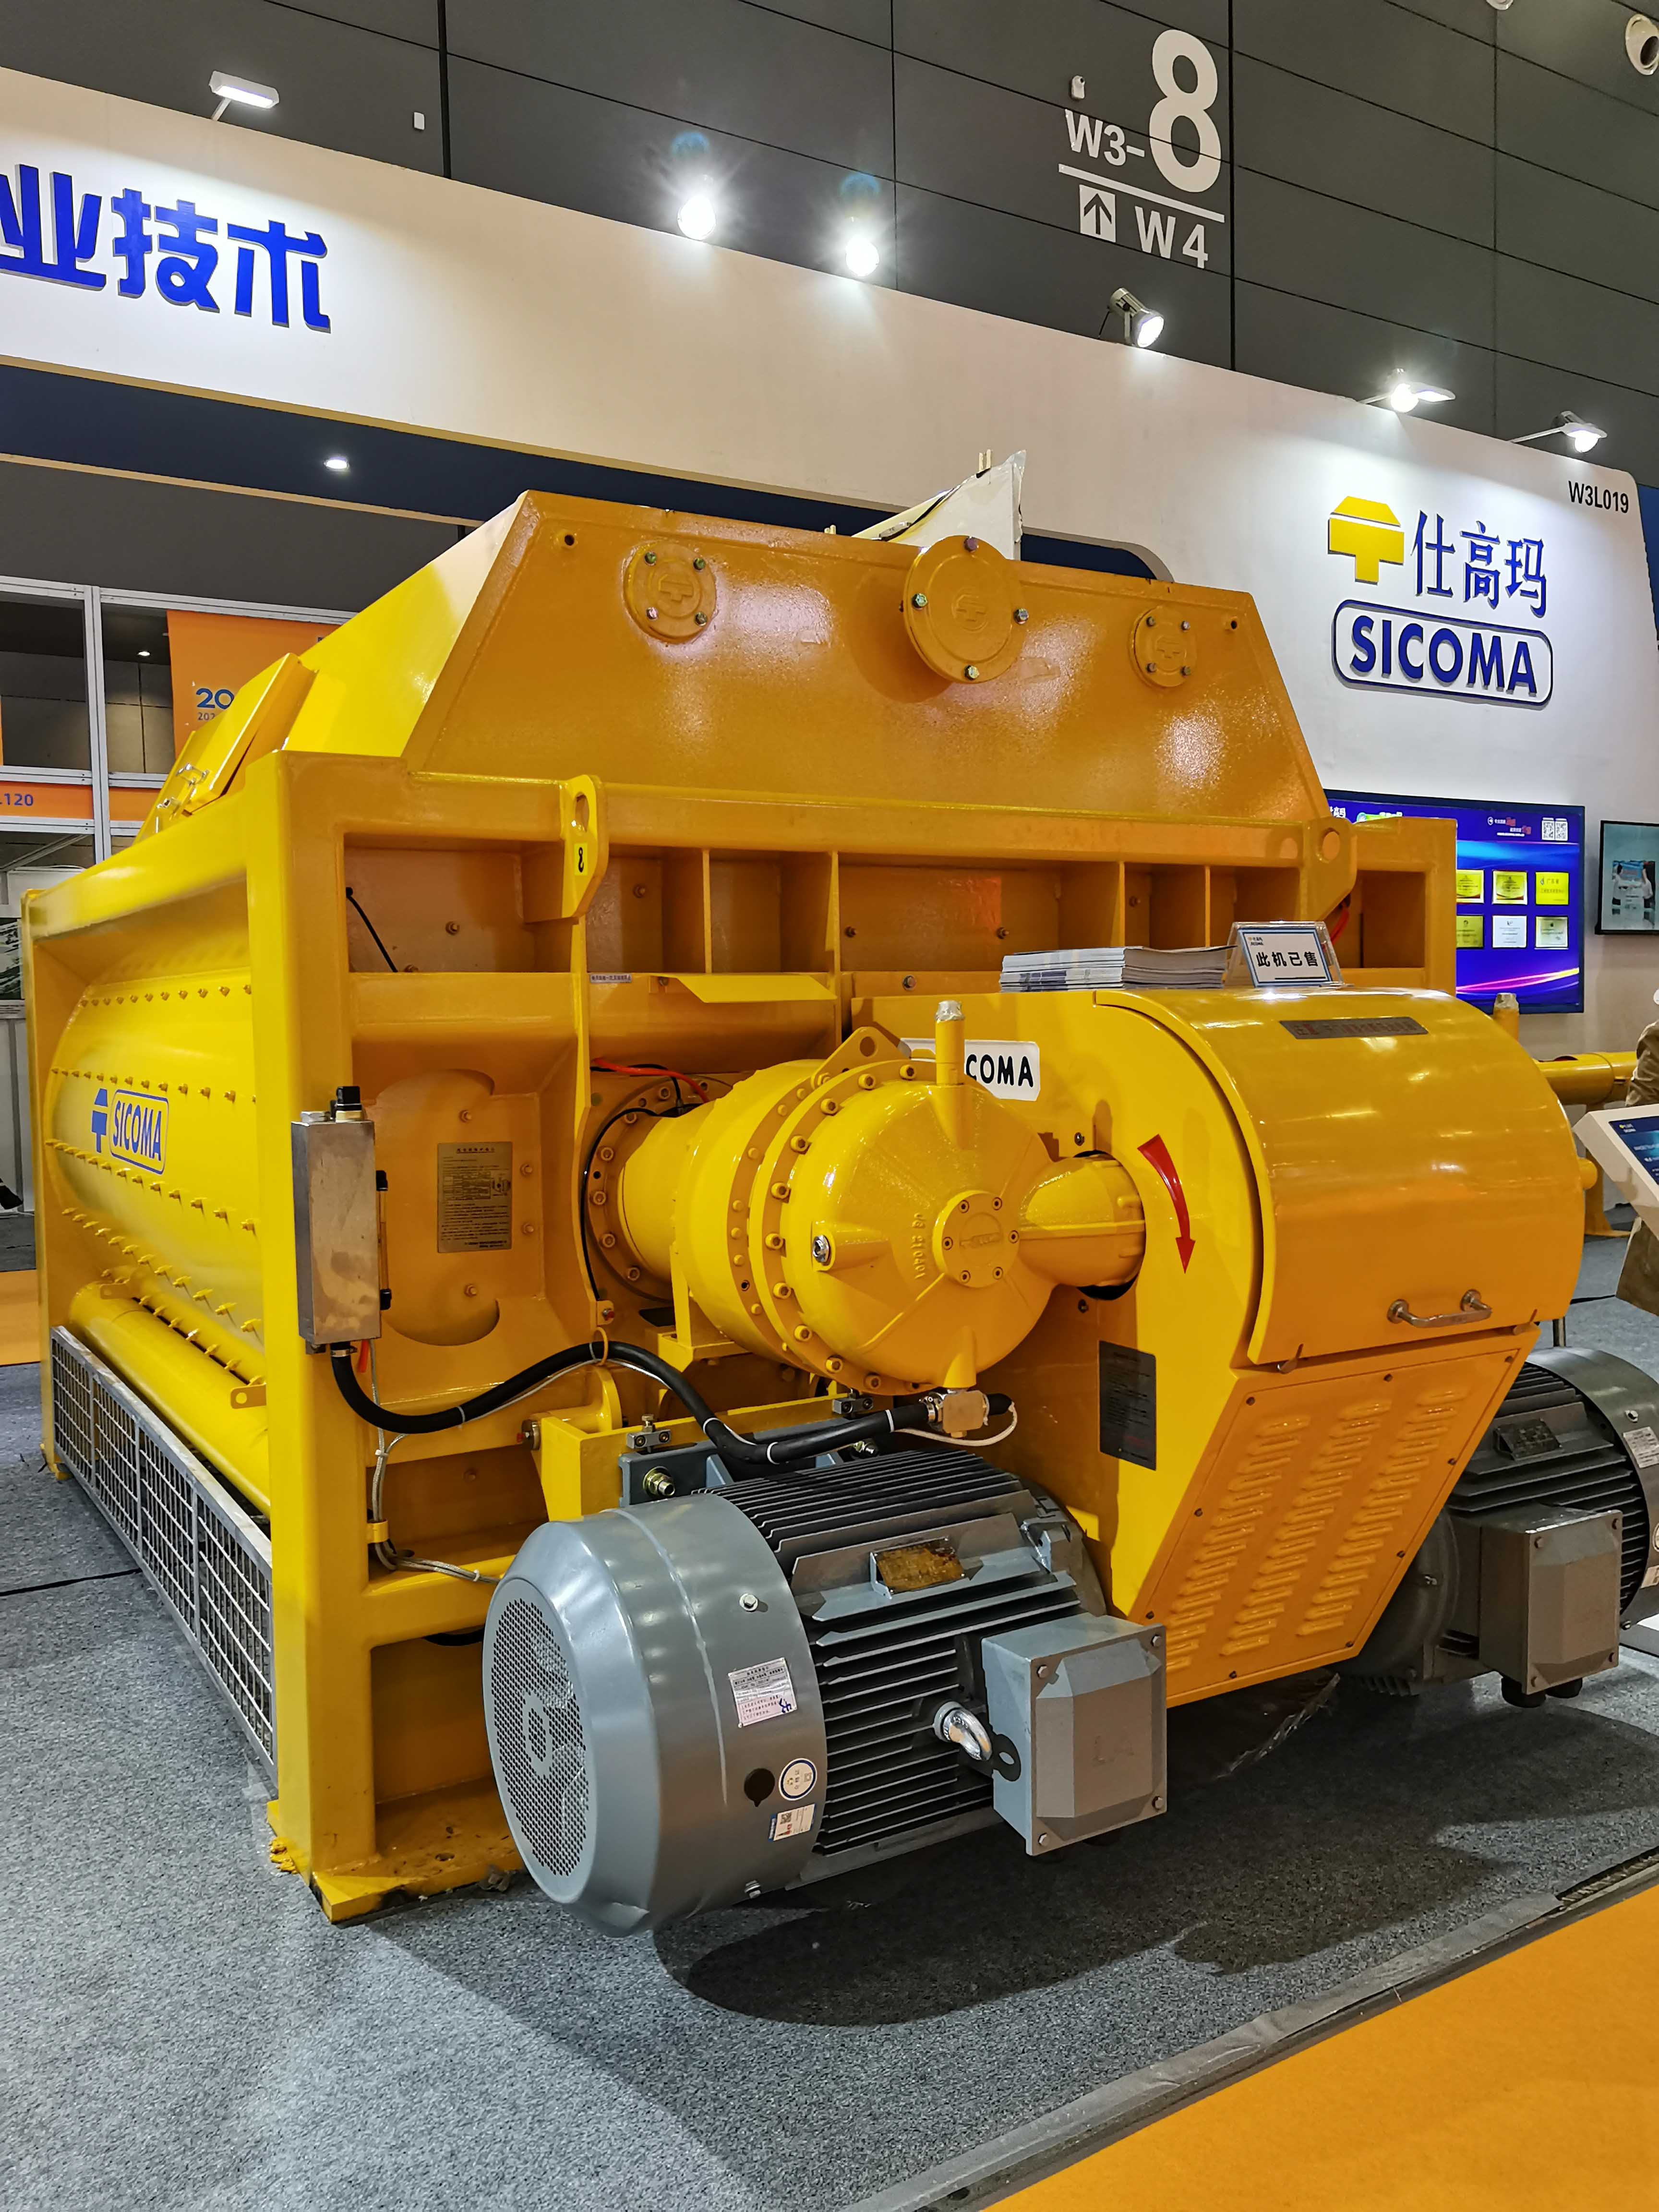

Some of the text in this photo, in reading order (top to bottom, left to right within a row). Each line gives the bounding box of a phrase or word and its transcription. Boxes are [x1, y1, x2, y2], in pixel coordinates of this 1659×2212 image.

[0, 164, 331, 333] 业技术
[1568, 481, 1629, 514] W3L019
[1411, 511, 1547, 618] 仕高玛
[1350, 615, 1538, 696] SICOMA
[0, 793, 33, 806] 120
[1256, 951, 1318, 967] 此机已售
[113, 1100, 162, 1161] SICOMA
